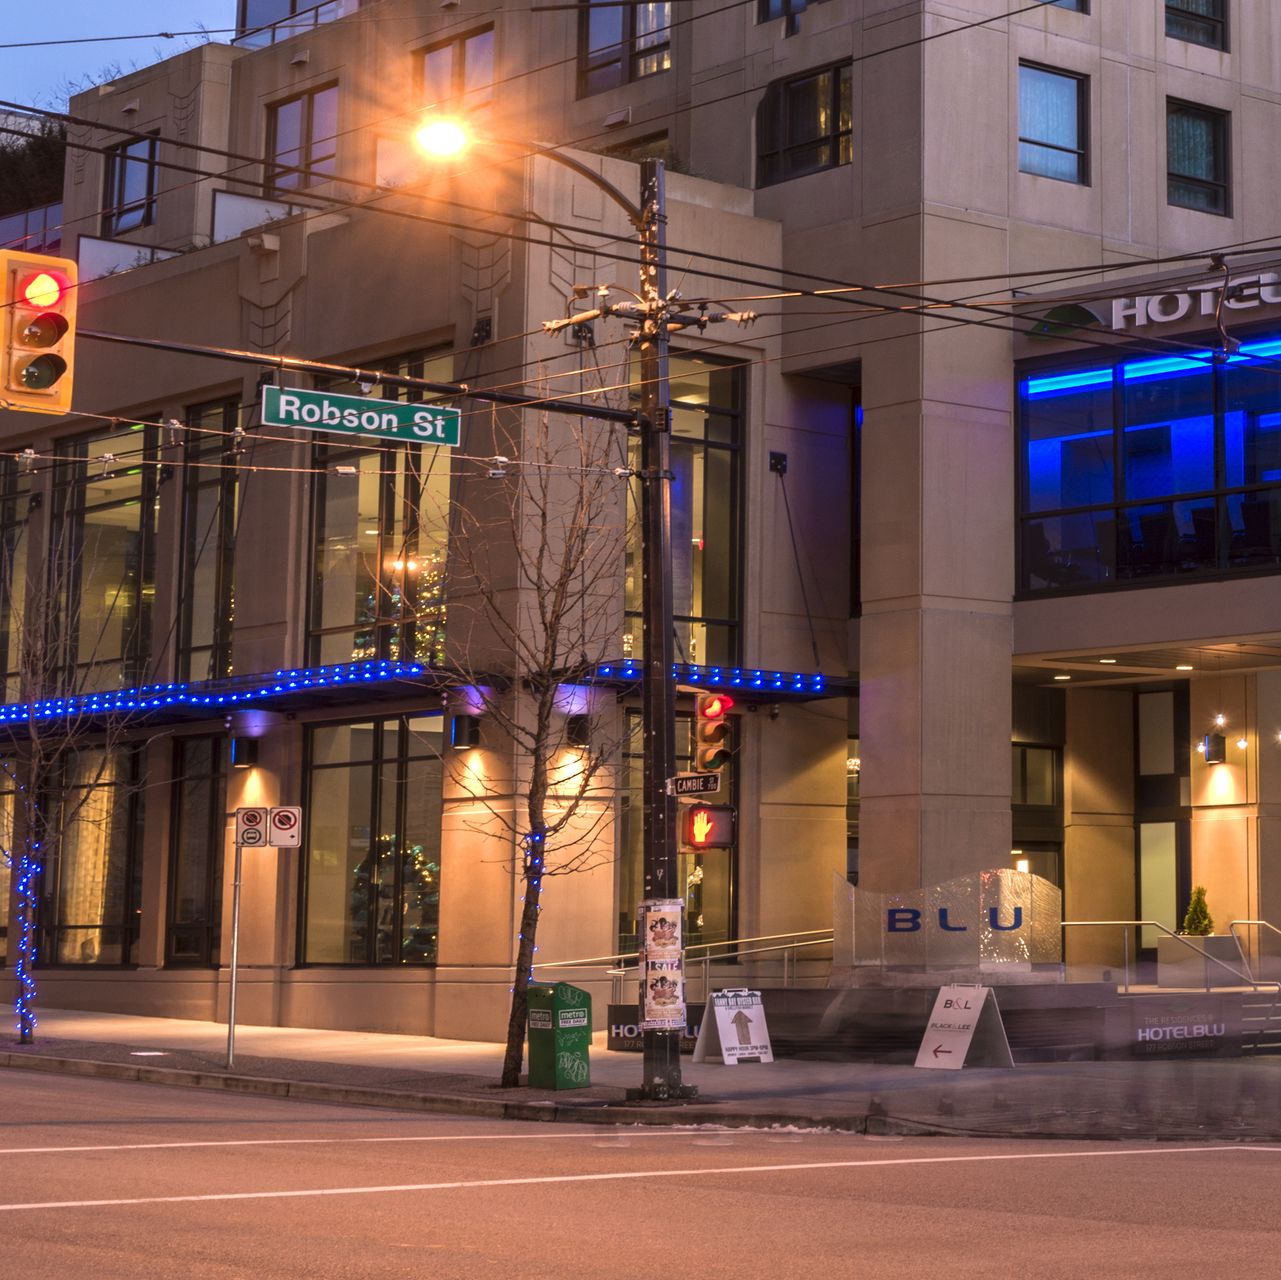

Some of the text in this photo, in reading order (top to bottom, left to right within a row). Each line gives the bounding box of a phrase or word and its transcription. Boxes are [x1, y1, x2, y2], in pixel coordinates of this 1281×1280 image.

[279, 394, 446, 438] Robson St
[677, 778, 704, 792] CAMBIE
[887, 906, 1023, 933] BLU
[561, 1011, 585, 1019] metro
[1138, 1023, 1225, 1041] HOTELBLU
